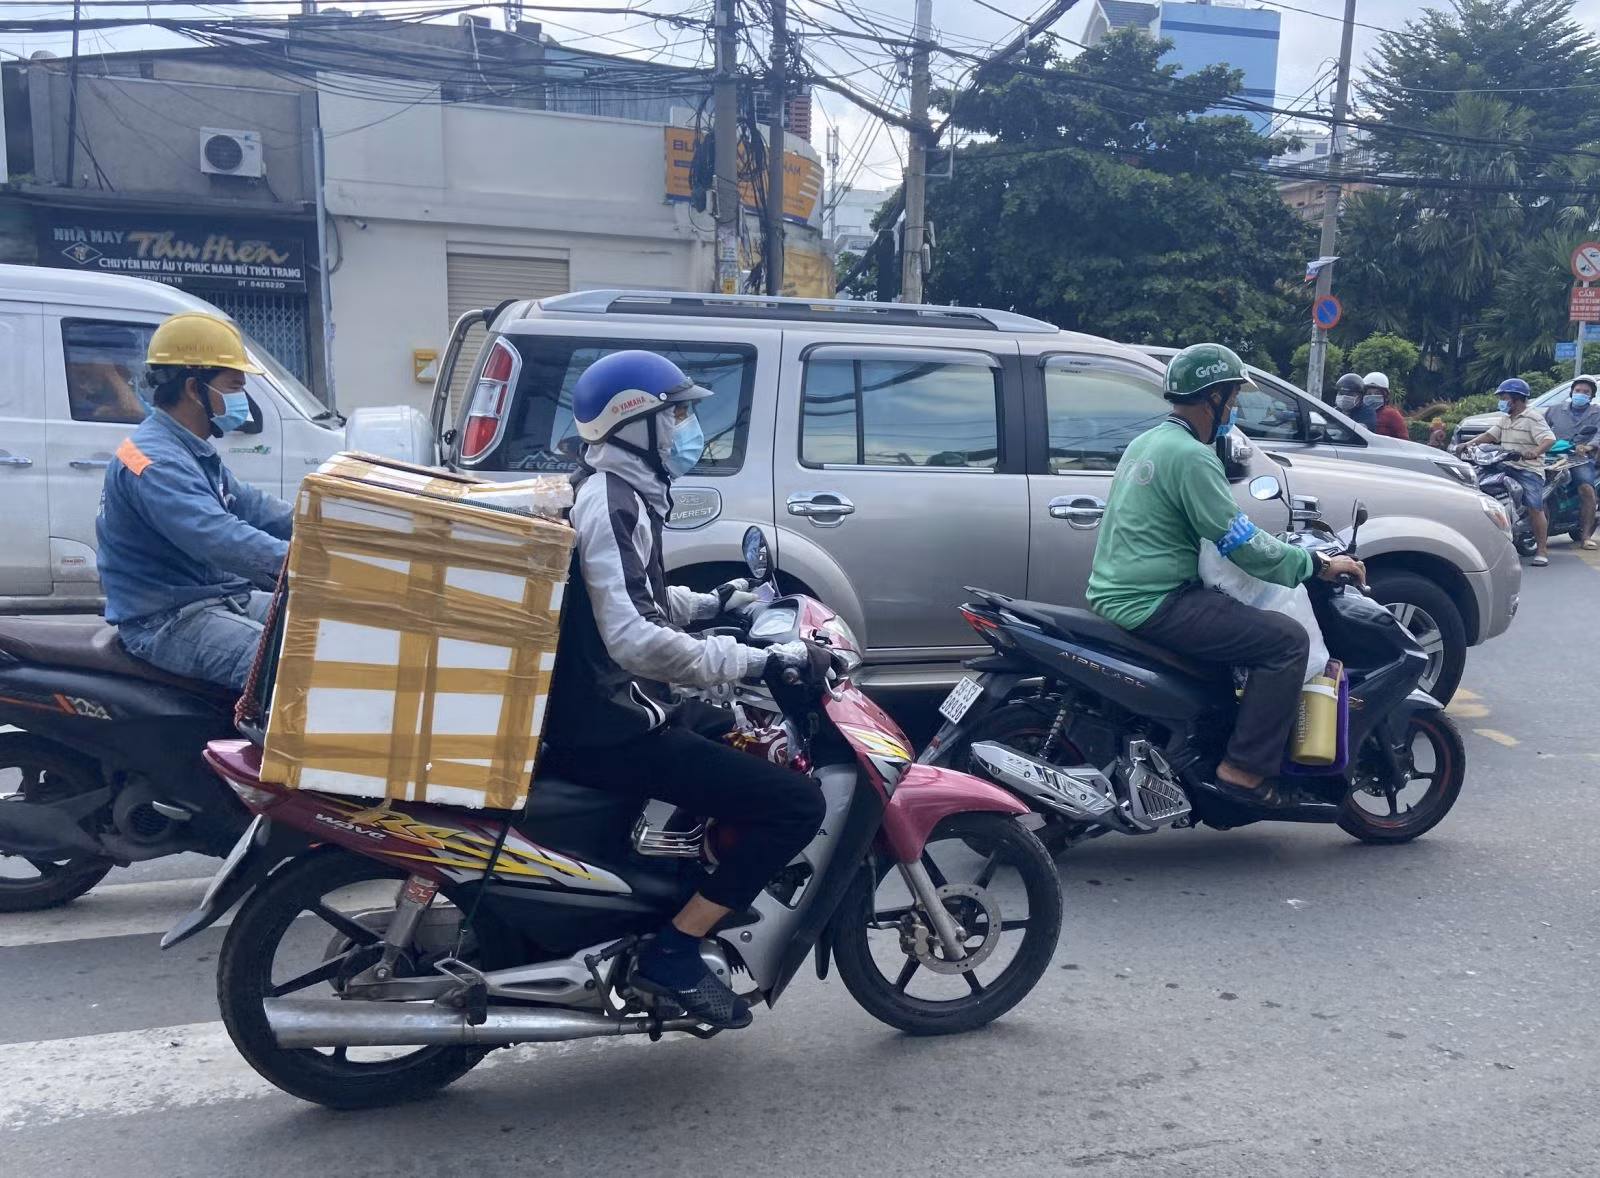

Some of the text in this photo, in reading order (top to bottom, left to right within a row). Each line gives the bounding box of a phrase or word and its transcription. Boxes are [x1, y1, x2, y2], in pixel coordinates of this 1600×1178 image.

[90, 229, 125, 244] MAY
[98, 256, 140, 270] CHUYÊN
[141, 260, 161, 271] MAY
[271, 266, 301, 279] TRANG
[1195, 359, 1229, 378] Grab
[619, 395, 647, 411] YAMAHA
[524, 460, 578, 470] EVERE
[670, 506, 714, 521] EVEREST
[1297, 699, 1306, 743] THERMAL
